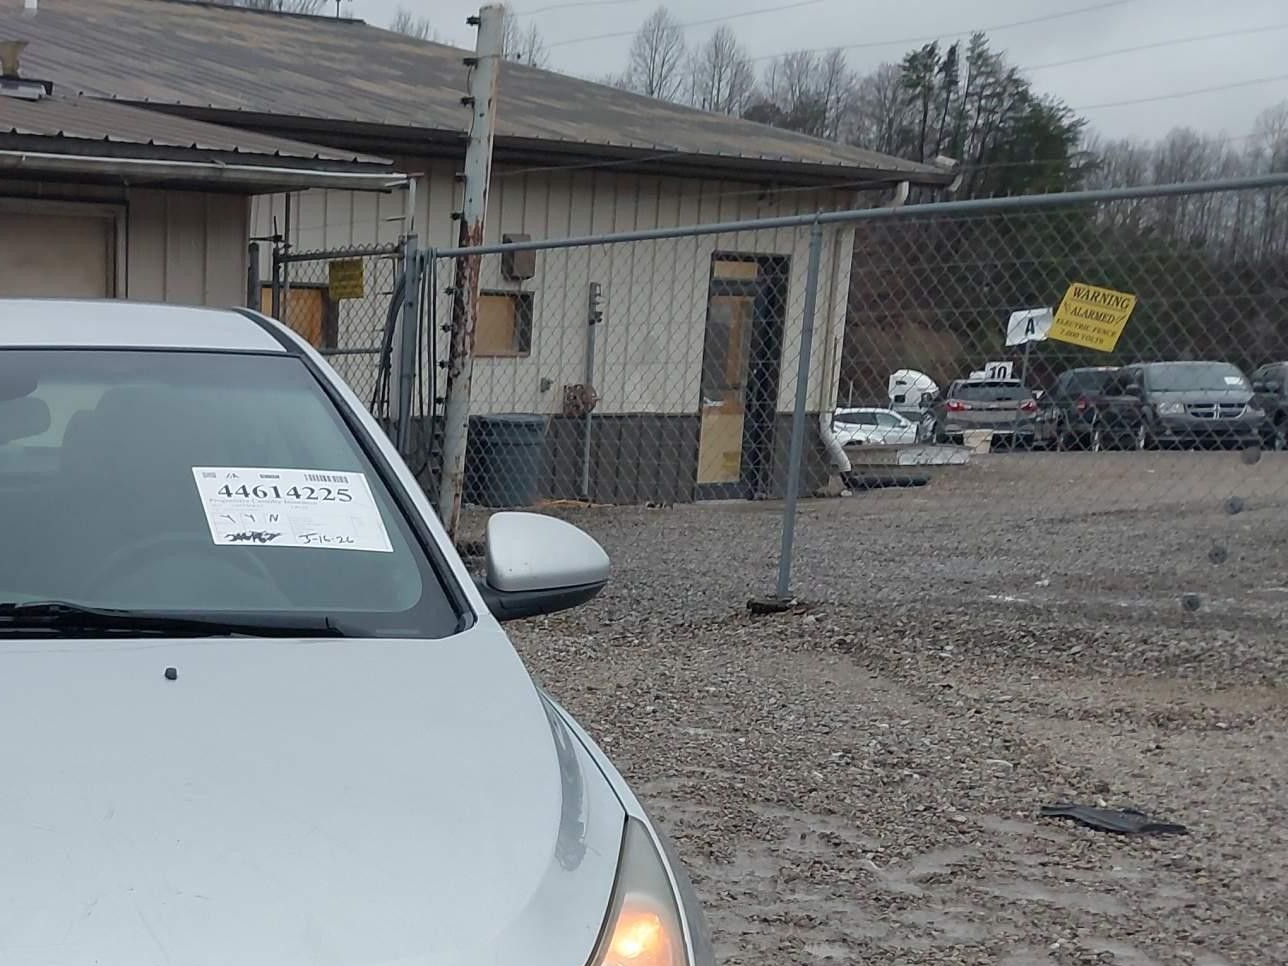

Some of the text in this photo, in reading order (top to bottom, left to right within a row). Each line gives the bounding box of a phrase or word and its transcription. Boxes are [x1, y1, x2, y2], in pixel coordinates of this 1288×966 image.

[1072, 287, 1131, 310] WARNING
[1070, 306, 1116, 324] ALARMED
[1025, 318, 1035, 336] A
[989, 366, 1007, 379] 10
[217, 484, 353, 503] 44614225
[269, 513, 279, 523] N
